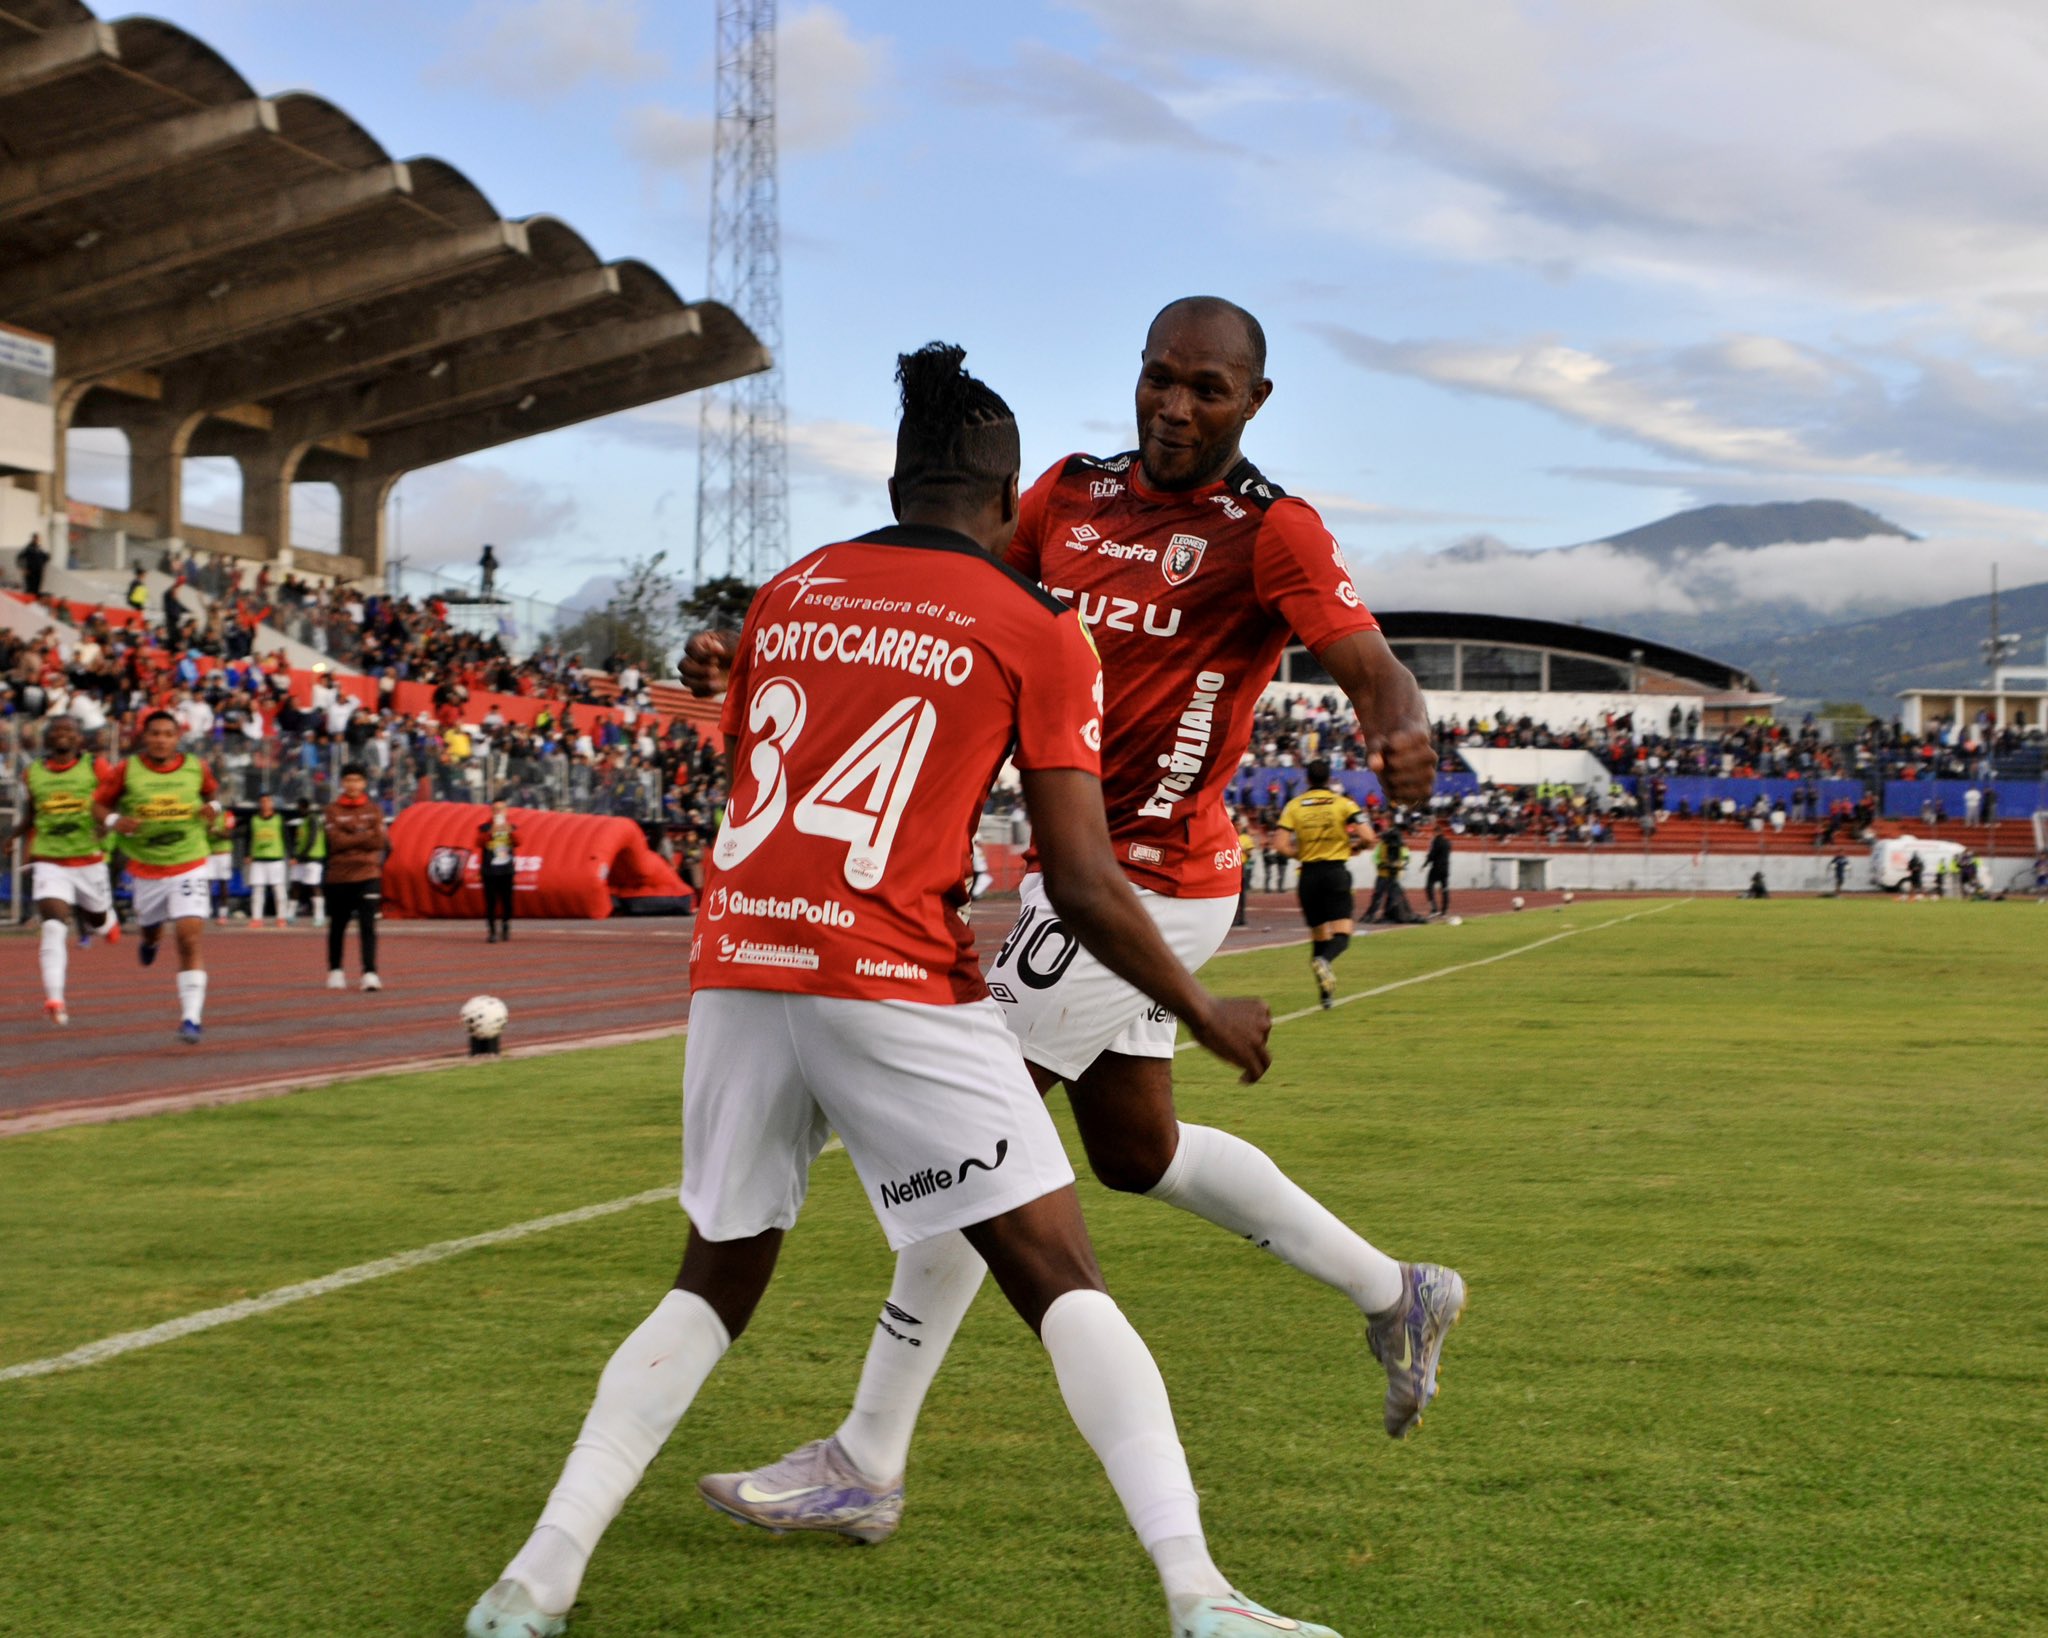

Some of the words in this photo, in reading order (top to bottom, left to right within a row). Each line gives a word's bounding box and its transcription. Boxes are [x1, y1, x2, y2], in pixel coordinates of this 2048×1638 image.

[1097, 540, 1158, 563] SanFra
[1173, 536, 1205, 551] LEONES
[804, 593, 912, 612] aseguradora
[916, 600, 946, 618] del
[945, 609, 977, 628] sur
[1037, 581, 1182, 637] SUZU
[754, 621, 974, 687] PORTOCARRERO
[712, 676, 937, 890] 34
[728, 890, 856, 929] GustaPollo
[739, 938, 816, 956] farmacias
[855, 957, 929, 981] Hidralife
[880, 1167, 953, 1209] Netlife
